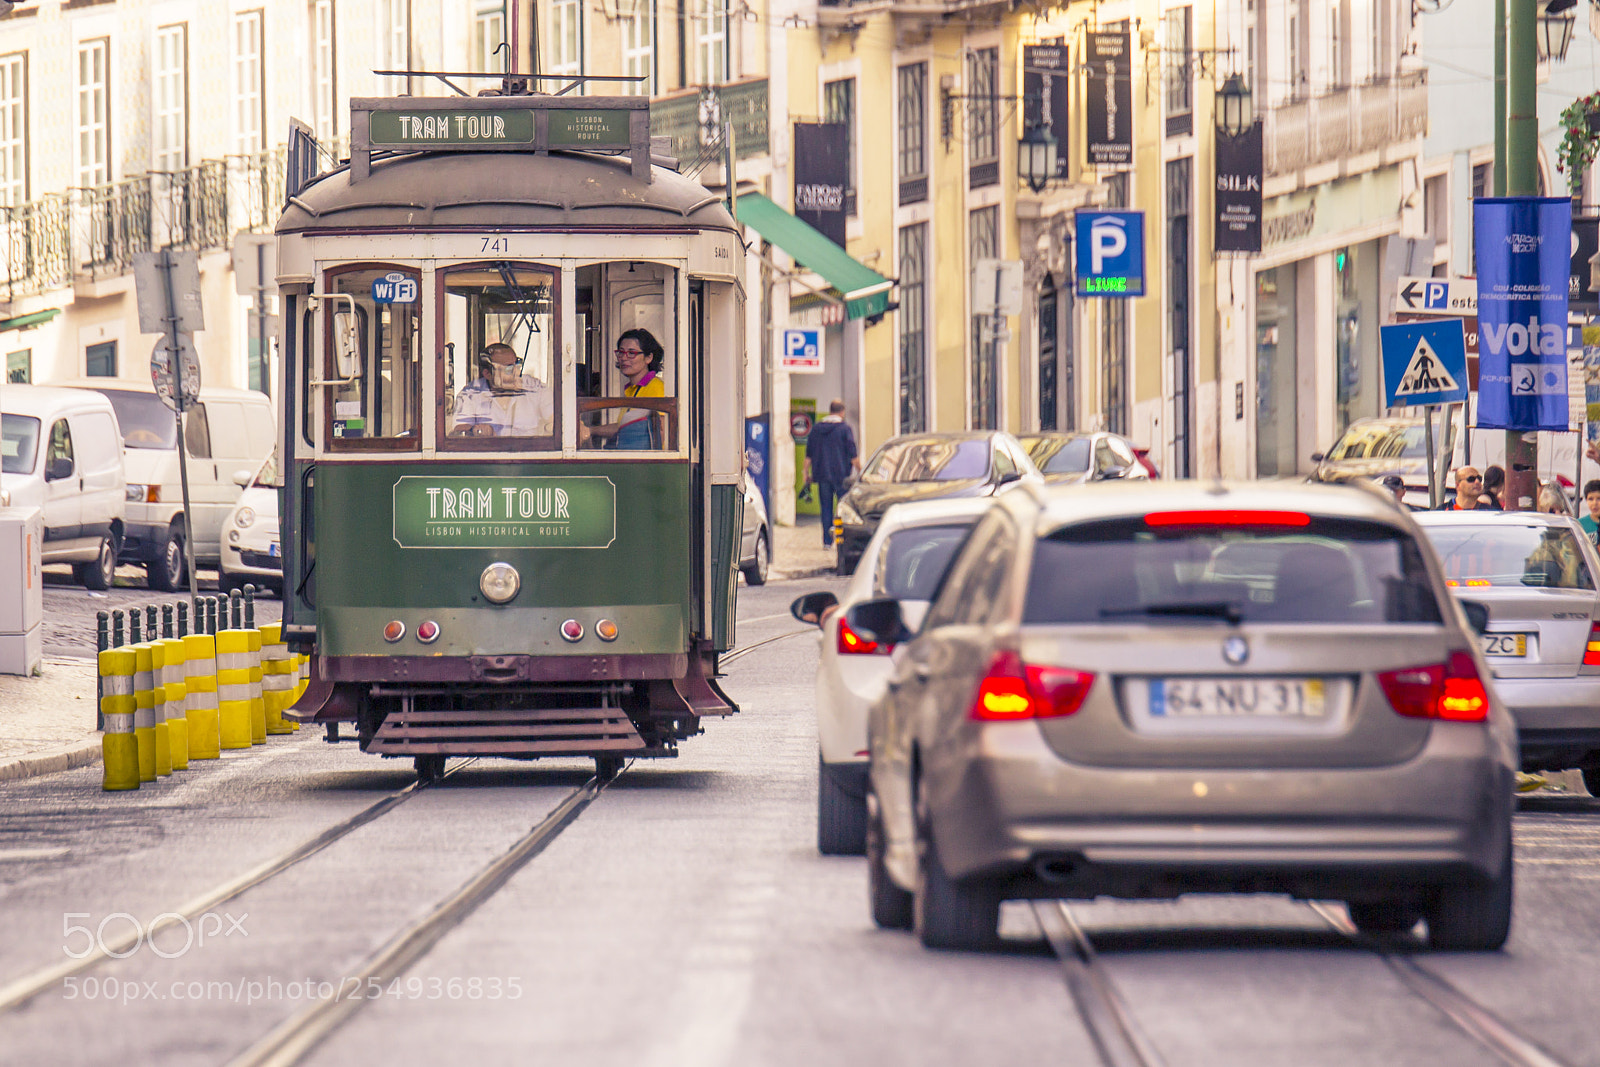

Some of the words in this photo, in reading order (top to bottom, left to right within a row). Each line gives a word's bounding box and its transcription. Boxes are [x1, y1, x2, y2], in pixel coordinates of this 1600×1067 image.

[399, 115, 449, 139] TRAM
[455, 115, 506, 139] TOUR
[797, 184, 831, 197] FADO
[1217, 174, 1260, 191] SILK
[481, 238, 508, 252] 741
[1086, 277, 1127, 292] LIVRE
[1481, 315, 1564, 356] vota
[426, 487, 492, 518] TRAM
[501, 487, 570, 518] TOUR
[426, 527, 461, 536] LISBON
[470, 527, 530, 536] HISTORICAL
[540, 527, 570, 536] ROUTE
[1485, 636, 1514, 653] ZC
